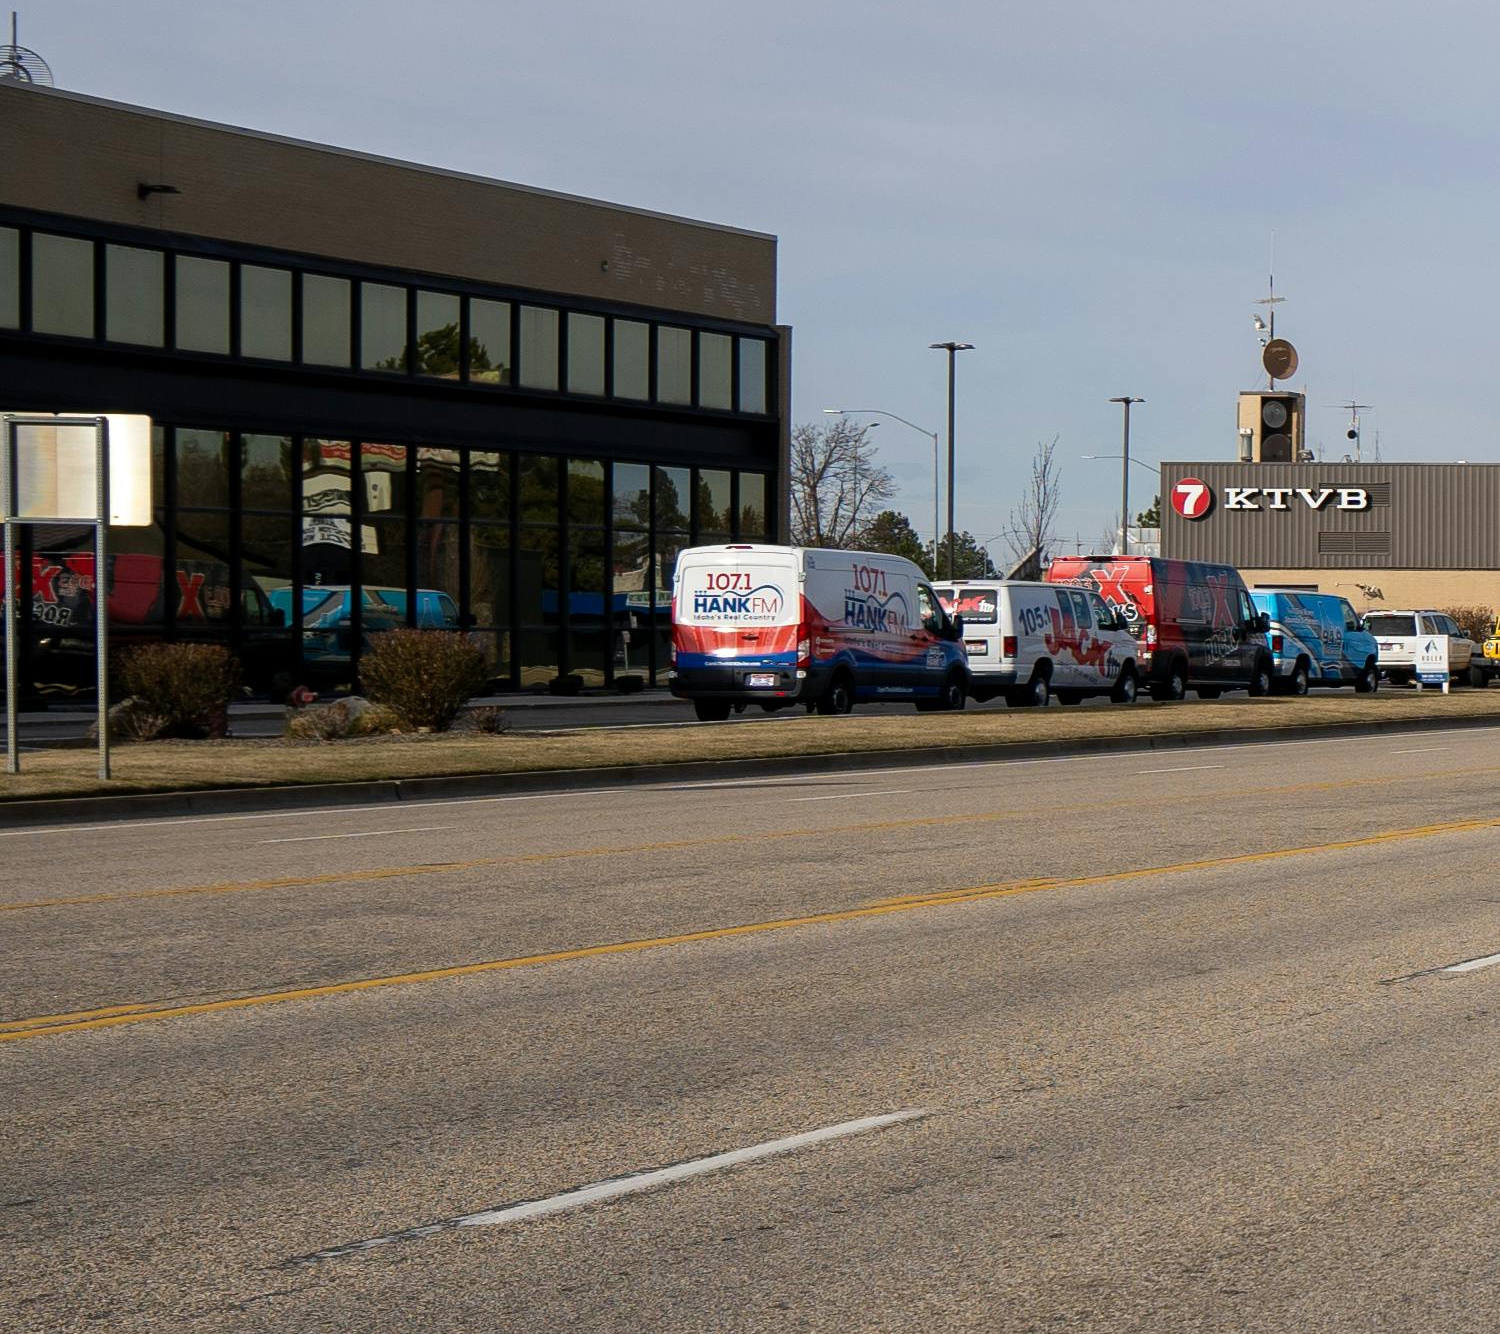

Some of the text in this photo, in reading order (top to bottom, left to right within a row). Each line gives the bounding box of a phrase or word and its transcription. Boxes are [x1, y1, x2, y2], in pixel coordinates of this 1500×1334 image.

[1176, 484, 1205, 515] 7
[1223, 487, 1369, 510] KTVB
[707, 573, 752, 591] 107.1
[852, 563, 888, 597] 107.1
[1018, 606, 1051, 636] 105.1
